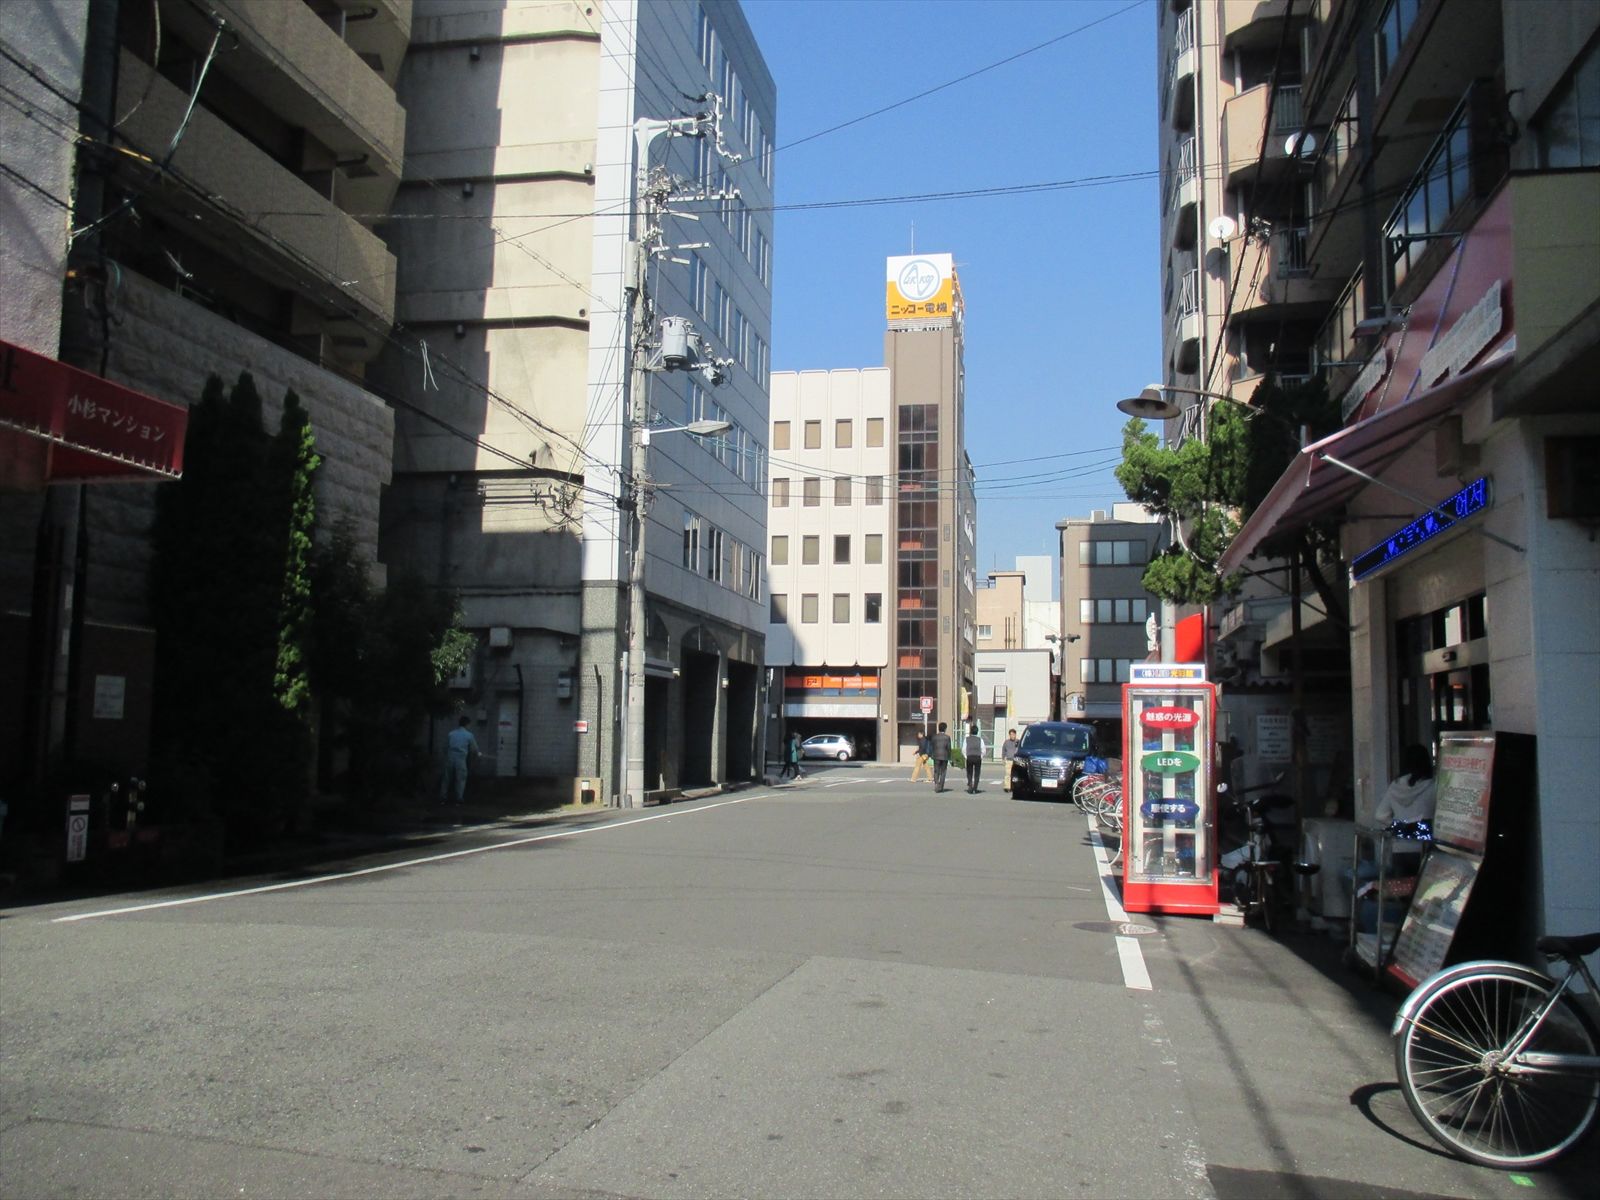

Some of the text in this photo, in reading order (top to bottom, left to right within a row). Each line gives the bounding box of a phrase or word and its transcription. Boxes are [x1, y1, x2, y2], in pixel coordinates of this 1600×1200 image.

[891, 302, 947, 315] ニッコー電機
[67, 394, 166, 442] 小杉マンション
[1145, 711, 1192, 722] 魅惑の光源
[1157, 757, 1182, 767] LEDを
